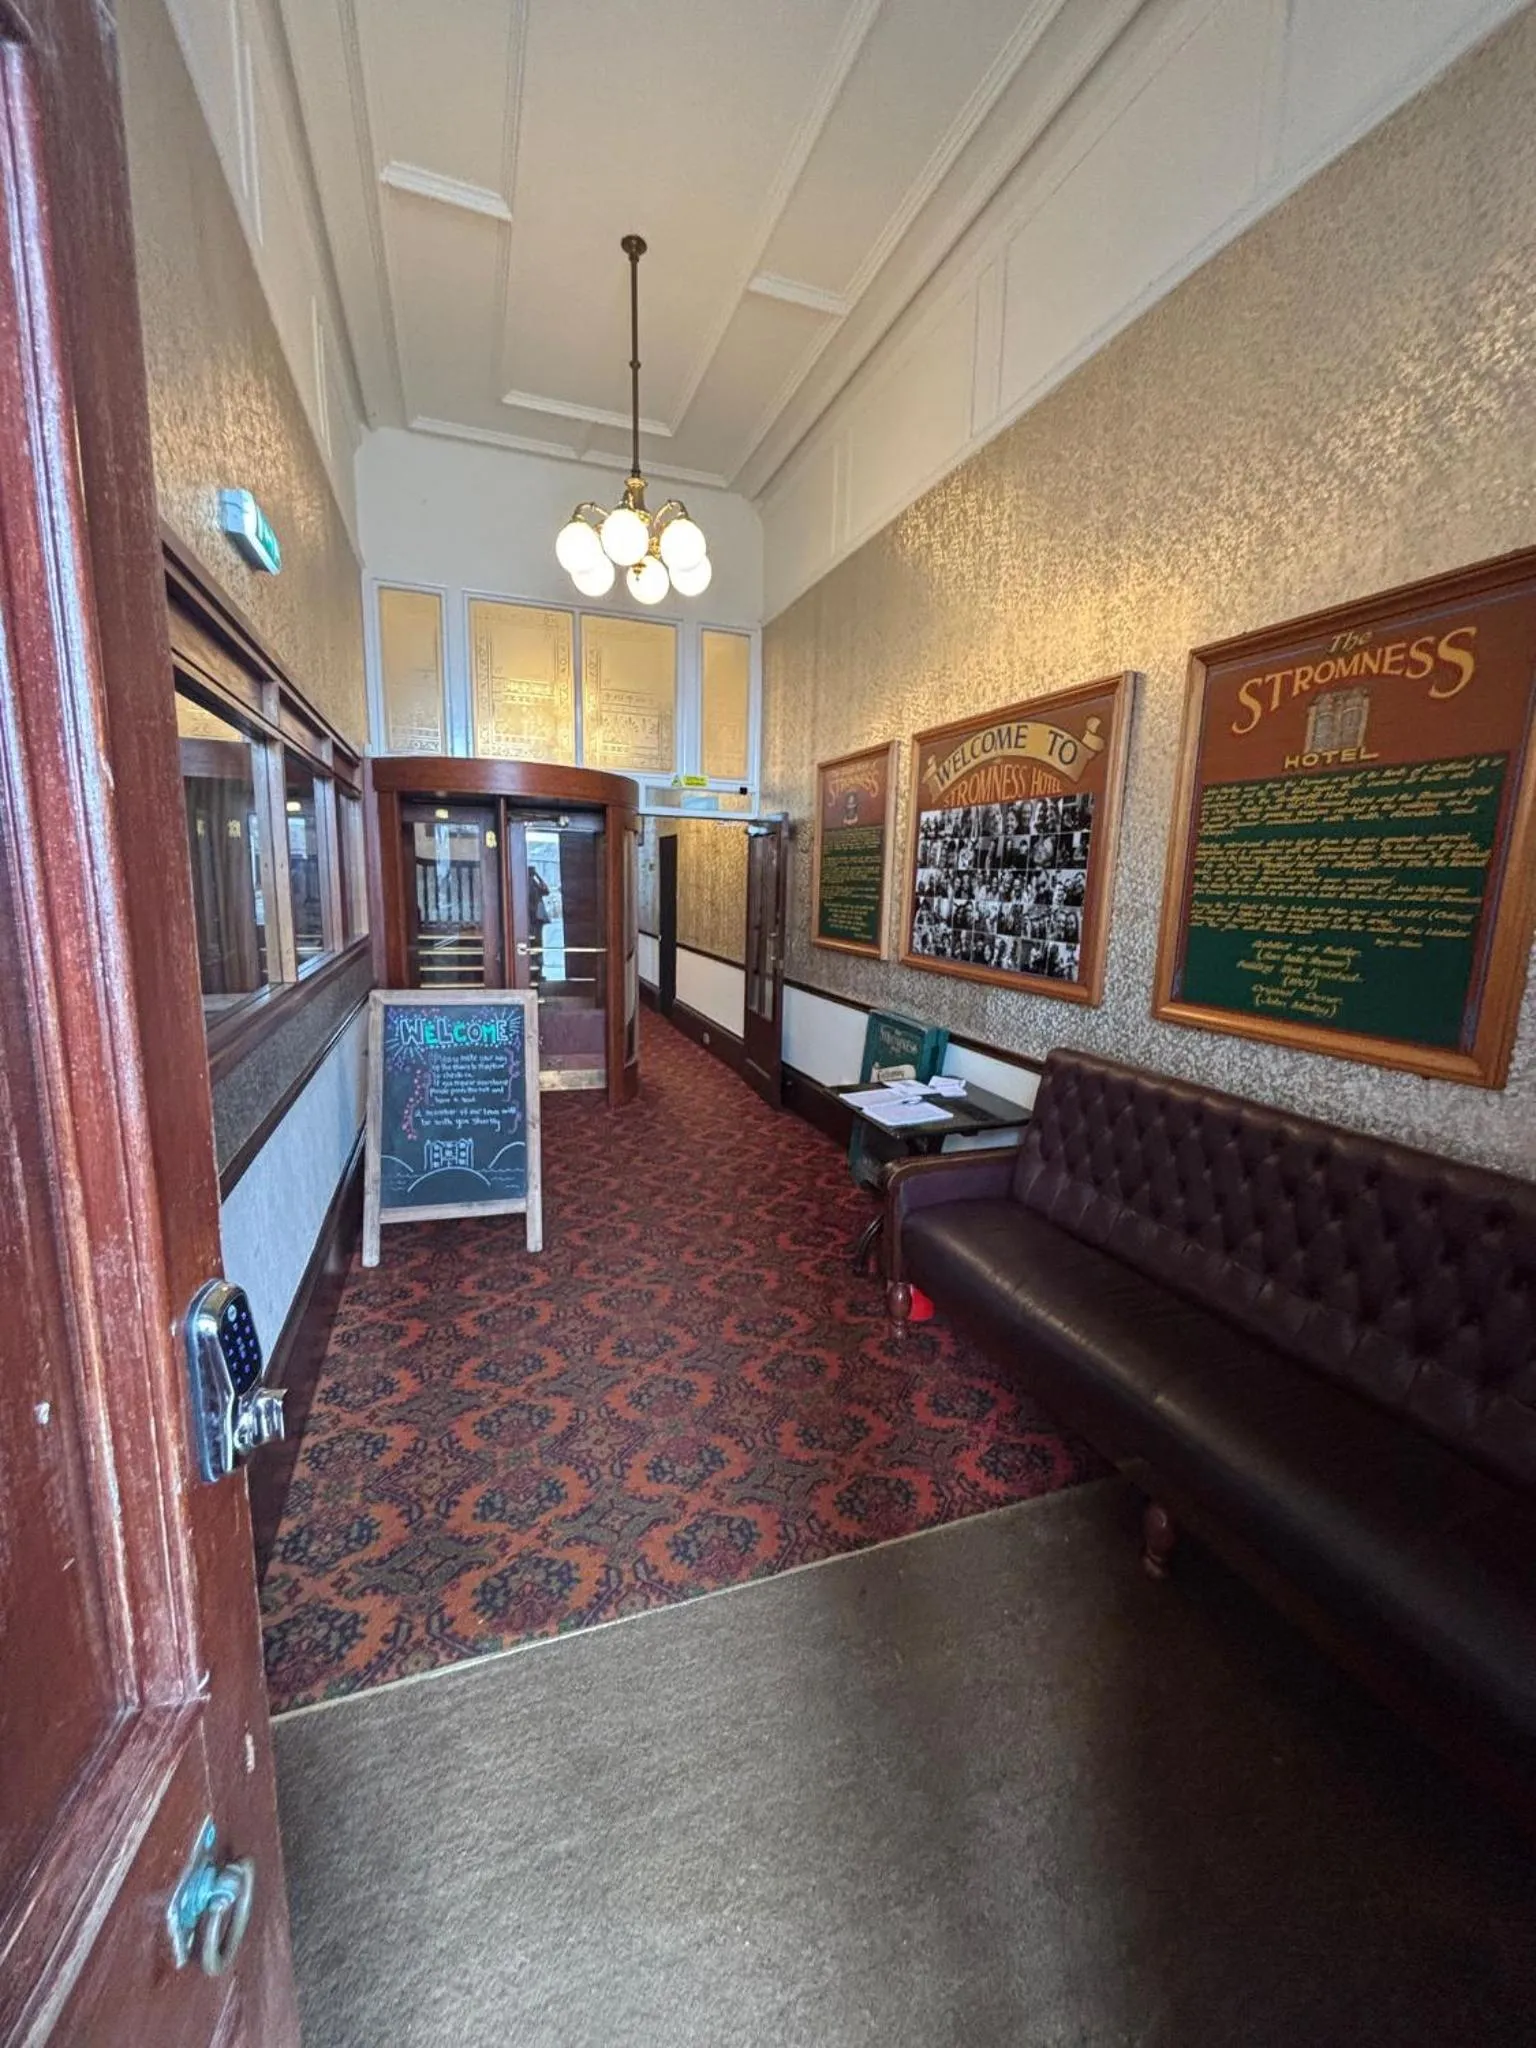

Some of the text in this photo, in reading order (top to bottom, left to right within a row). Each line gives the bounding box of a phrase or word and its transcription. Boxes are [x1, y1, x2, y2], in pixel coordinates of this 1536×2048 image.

[1328, 629, 1373, 653] The
[1231, 626, 1477, 734] STROMNESS
[934, 724, 1079, 786] WELCOME TO
[1284, 747, 1380, 770] HOTEL
[943, 764, 1063, 808] STROMNESS HOTEL
[400, 1018, 509, 1045] WELCOME
